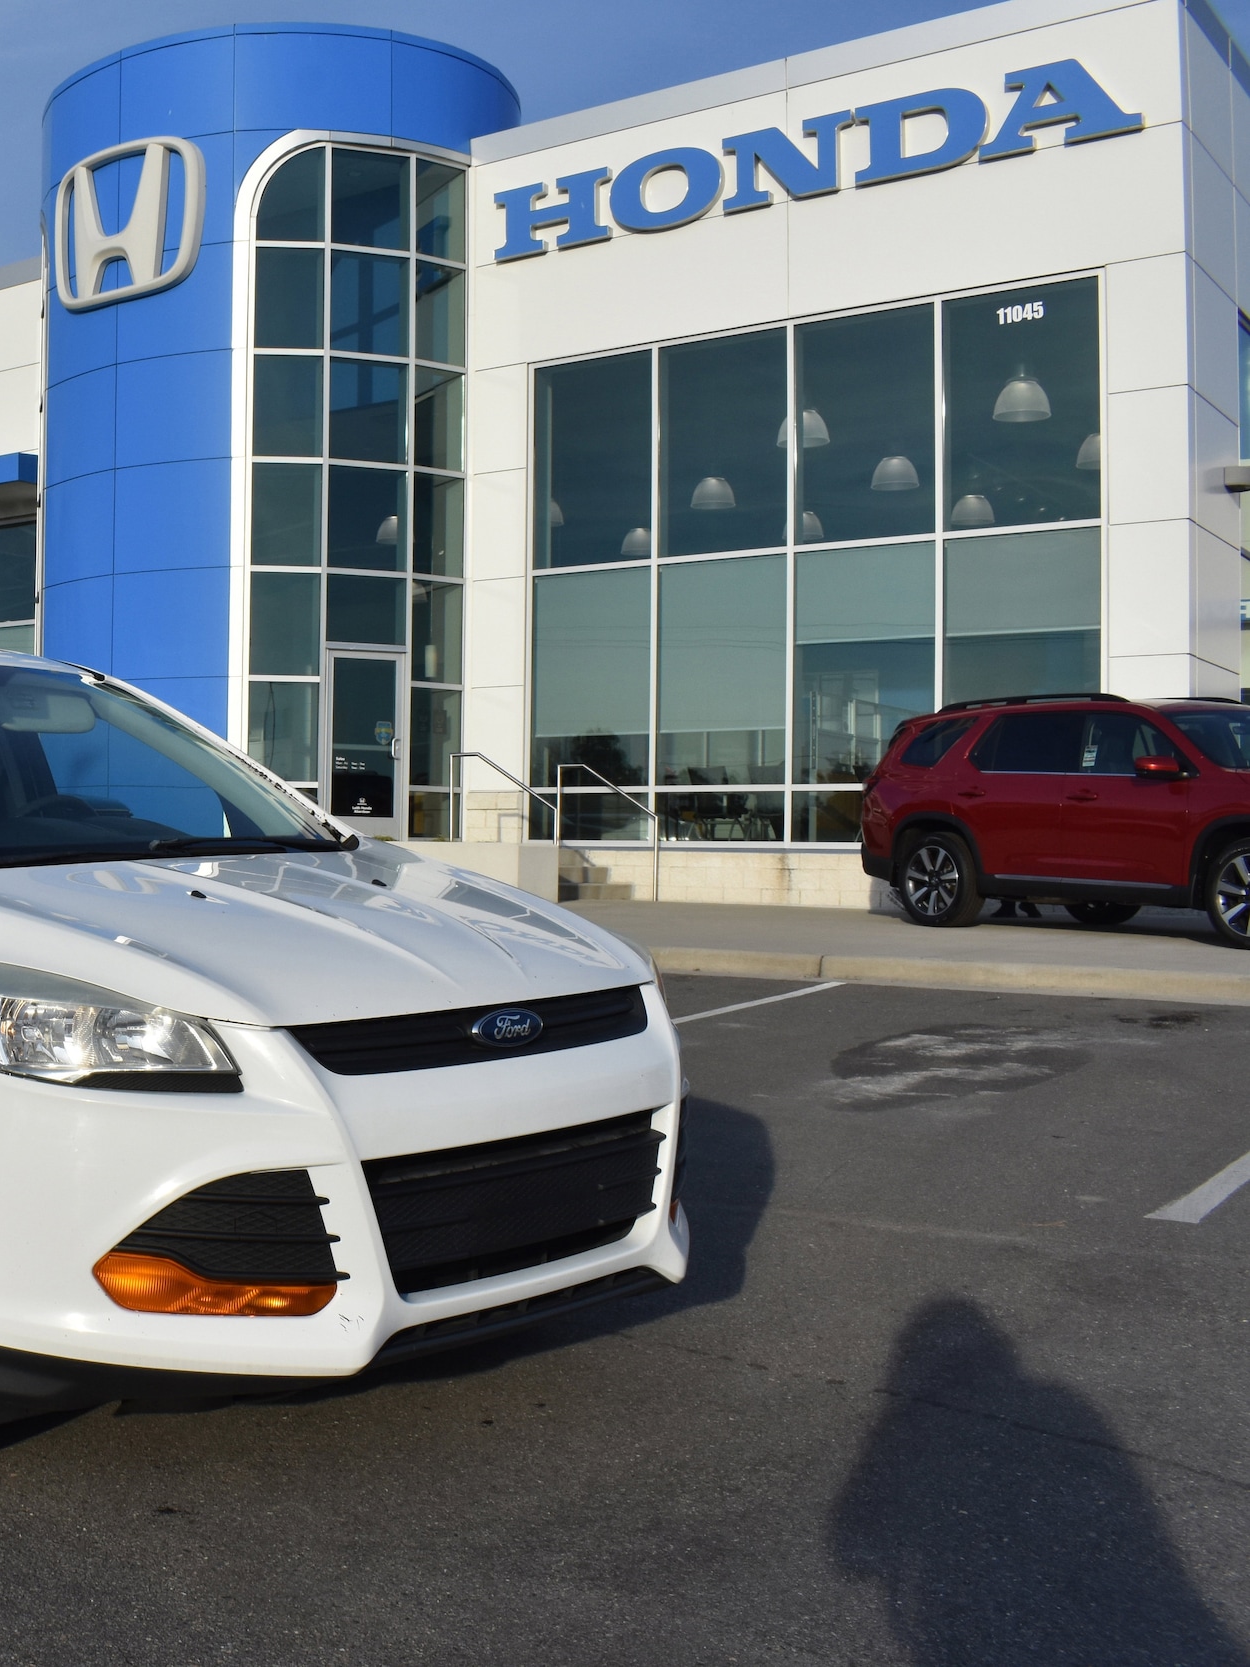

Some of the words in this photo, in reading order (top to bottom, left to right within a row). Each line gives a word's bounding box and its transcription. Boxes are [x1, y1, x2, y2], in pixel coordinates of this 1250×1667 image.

[494, 58, 1144, 261] HONDA
[996, 301, 1044, 325] 11045
[494, 1015, 530, 1040] Ford
